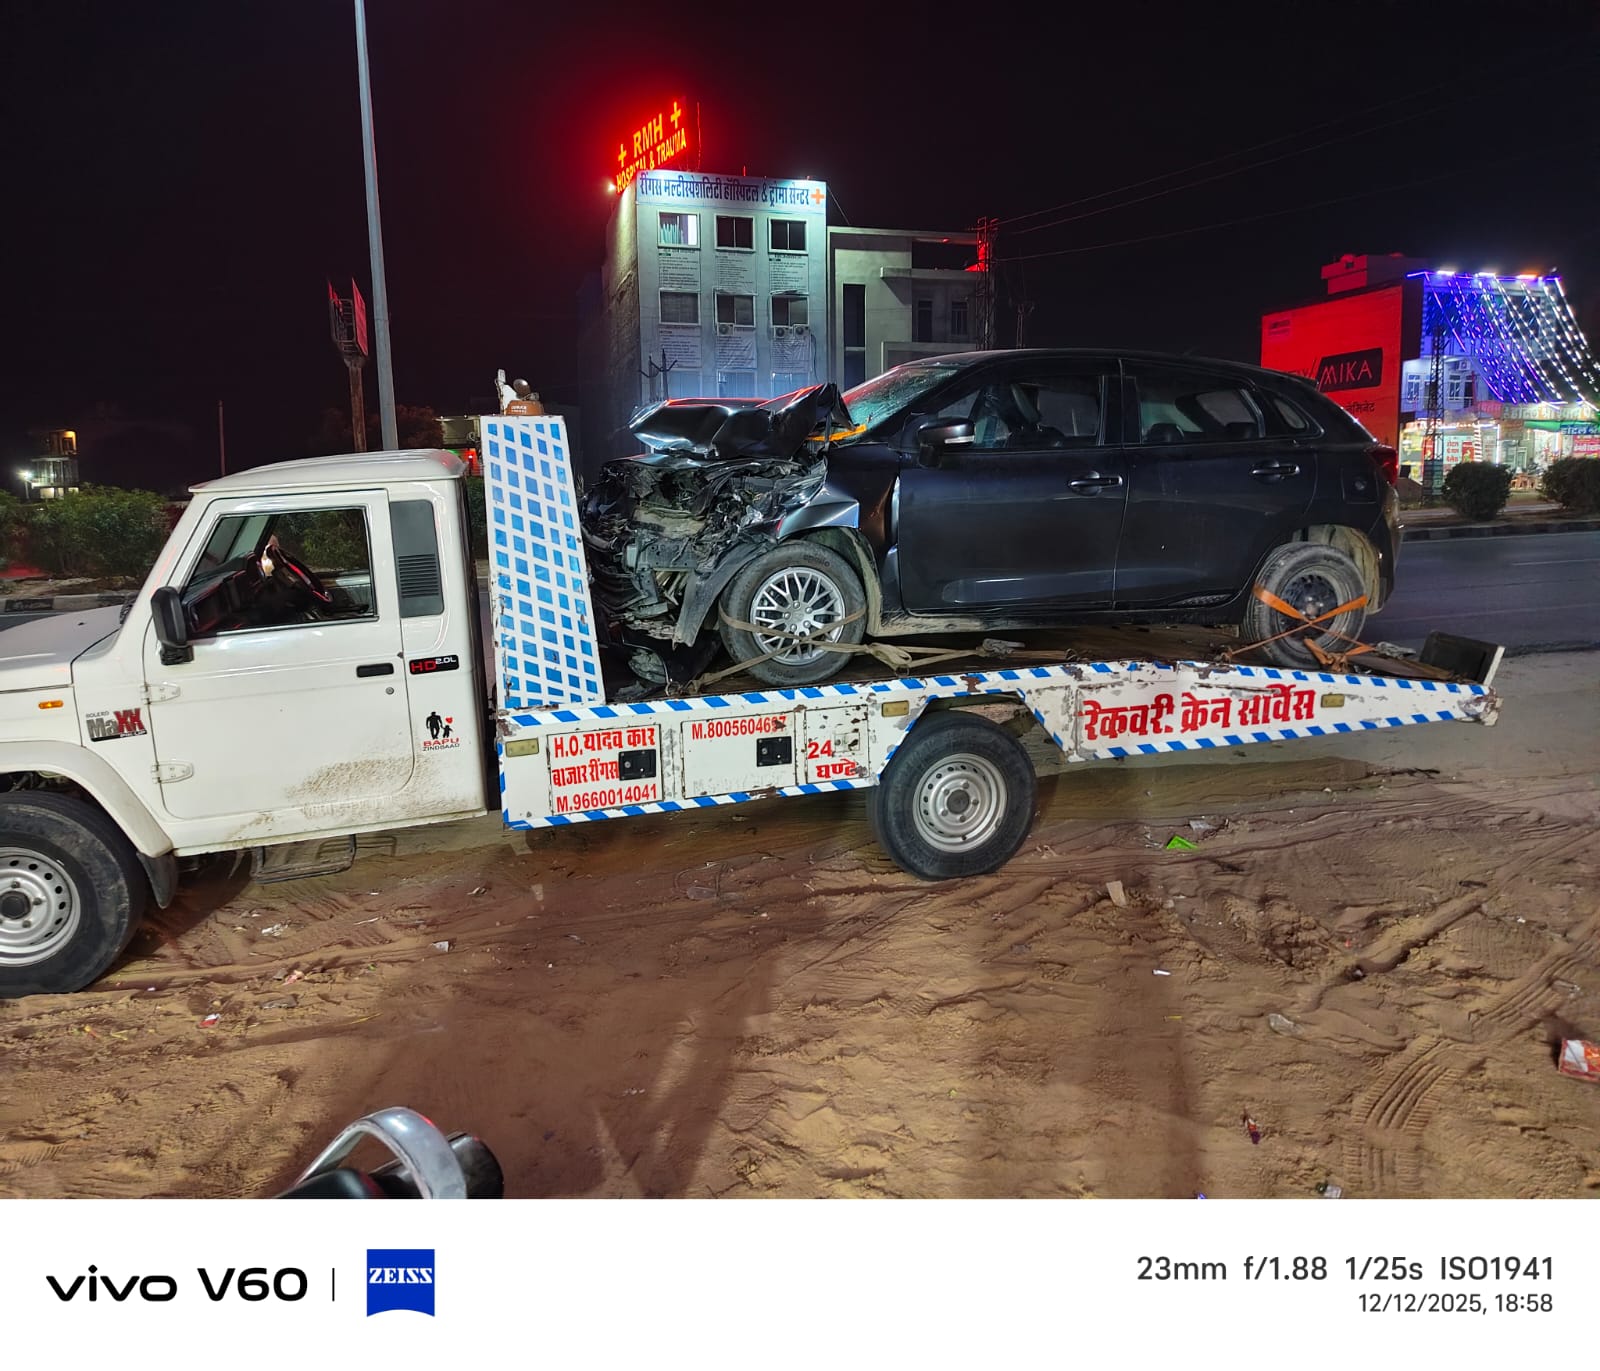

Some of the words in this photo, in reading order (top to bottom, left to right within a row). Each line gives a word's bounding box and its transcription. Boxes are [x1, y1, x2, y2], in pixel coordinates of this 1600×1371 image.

[633, 113, 663, 158] RMH
[656, 127, 687, 166] TRAUMA
[761, 182, 768, 203] &
[410, 660, 436, 672] HD
[1180, 692, 1233, 734] क्रेन
[423, 738, 460, 747] BAPU
[583, 730, 623, 751] यादव
[626, 728, 655, 747] कार
[807, 740, 833, 759] 24
[556, 783, 657, 813] M.9660014041
